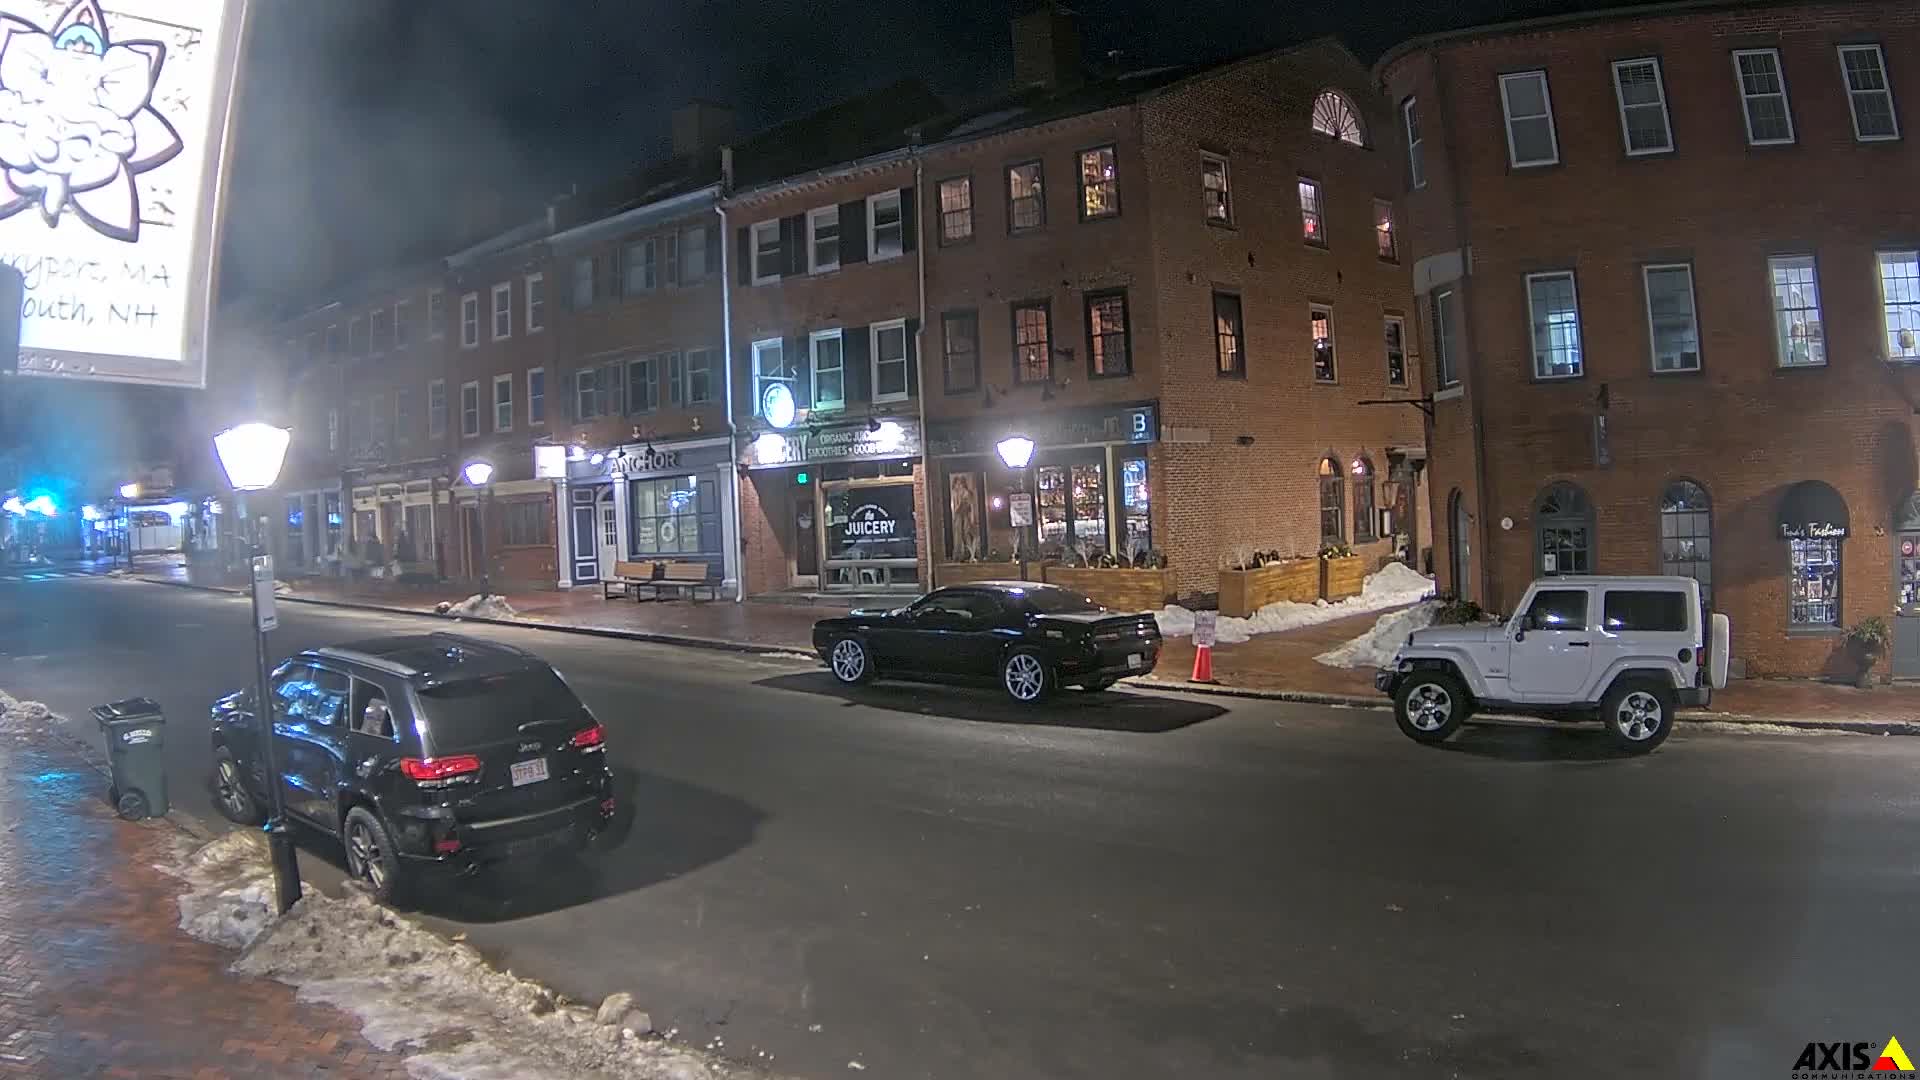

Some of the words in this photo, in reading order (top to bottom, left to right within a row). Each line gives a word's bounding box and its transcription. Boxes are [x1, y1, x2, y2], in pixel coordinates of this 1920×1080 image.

[108, 303, 159, 329] NH
[1132, 413, 1146, 432] B
[611, 451, 679, 473] ANCHOR
[844, 519, 896, 535] JUICERY
